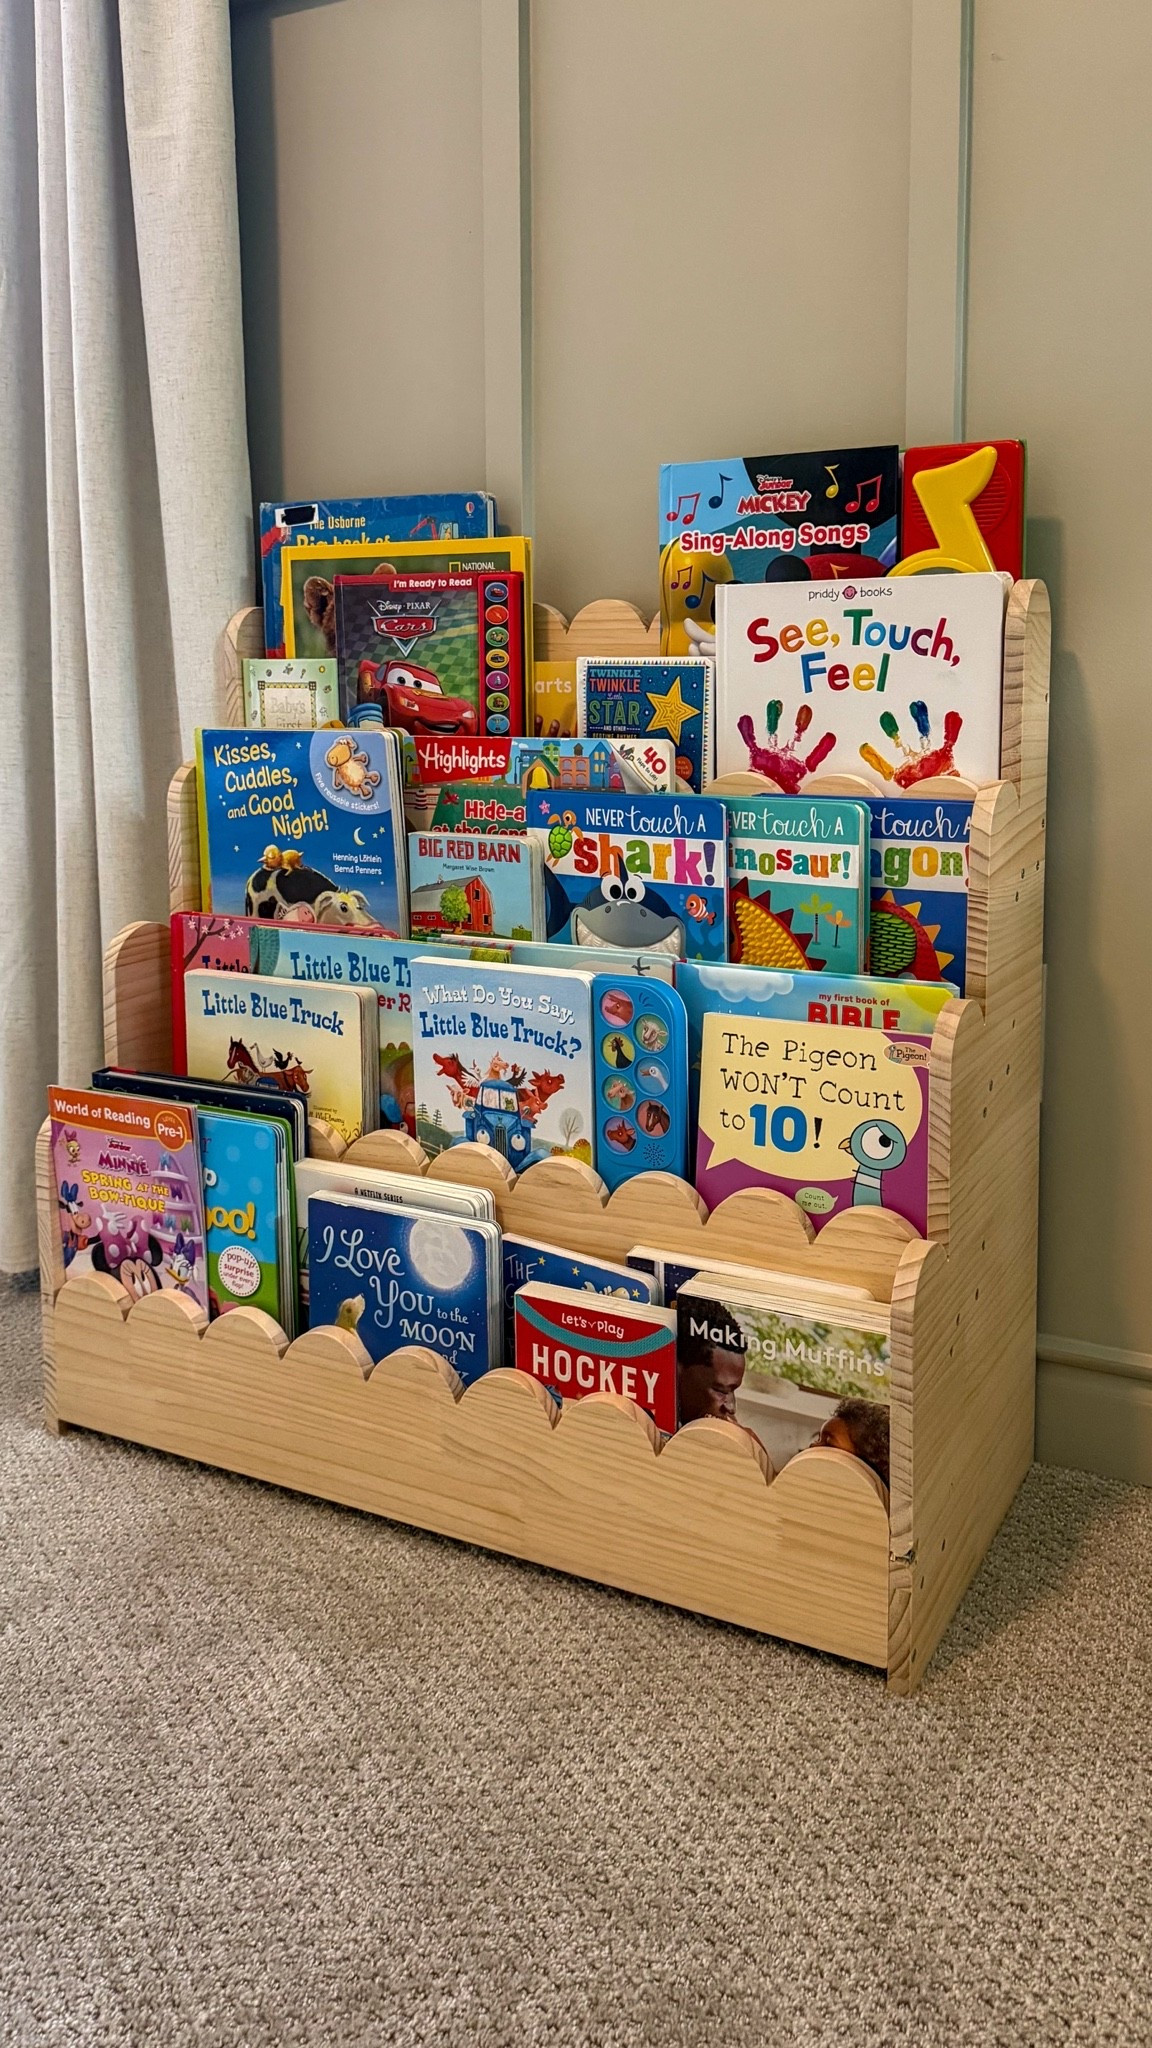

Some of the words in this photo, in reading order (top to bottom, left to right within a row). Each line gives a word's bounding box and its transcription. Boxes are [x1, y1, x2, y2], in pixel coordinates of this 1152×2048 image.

[737, 490, 812, 515] MICKEY
[328, 516, 366, 530] Usborne
[680, 526, 796, 555] Sing-Along
[798, 522, 871, 547] Songs
[462, 562, 496, 571] NATIONAL
[393, 580, 407, 588] I'm
[409, 579, 436, 588] Ready
[438, 579, 447, 587] to
[449, 578, 472, 587] Read
[808, 588, 840, 602] priddy
[860, 585, 893, 598] books
[376, 600, 402, 613] Disney
[406, 602, 432, 610] PIXAR
[380, 619, 428, 632] Cars
[746, 617, 840, 663] See,
[843, 608, 961, 667] Touch,
[589, 668, 641, 678] TWINKLE
[589, 678, 641, 692] TWINKLE
[800, 651, 891, 694] Feel
[589, 700, 640, 726] STAR
[213, 742, 276, 767] Kisses,
[418, 743, 506, 774] Highlights
[643, 746, 667, 775] 40
[225, 766, 299, 793] Cuddles,
[227, 804, 247, 819] and
[248, 789, 295, 816] Good
[323, 786, 350, 807] reusable
[350, 801, 380, 811] stickers!
[465, 799, 526, 822] Hide-a
[271, 808, 330, 840] Night!
[585, 808, 625, 827] NEVER
[625, 805, 695, 836] touch
[697, 813, 707, 832] A
[728, 811, 756, 830] VER
[757, 807, 832, 838] touch
[834, 816, 844, 836] A
[875, 806, 960, 838] touch
[332, 853, 358, 863] Henning
[418, 838, 443, 858] BIG
[447, 840, 474, 860] RED
[478, 842, 521, 863] BARN
[573, 833, 716, 887] shark!
[334, 864, 354, 873] Bernd
[355, 866, 383, 875] Penners
[442, 863, 464, 871] Margaret
[290, 951, 343, 980] Little
[348, 951, 391, 983] Blue
[422, 984, 468, 1005] What
[472, 984, 497, 1005] Do
[498, 987, 534, 1011] You
[537, 995, 576, 1025] Say,
[819, 994, 832, 1002] my
[834, 993, 853, 1003] first
[855, 995, 877, 1005] book
[202, 989, 247, 1016] Little
[250, 992, 288, 1020] Blue
[289, 997, 344, 1036] Truck
[807, 1001, 902, 1031] BIBLE
[419, 1011, 467, 1039] Little
[471, 1012, 509, 1040] Blue
[510, 1016, 582, 1060] Truck?
[722, 1032, 770, 1058] The
[782, 1039, 877, 1072] Pigeon
[896, 1050, 927, 1062] Pigeon!
[720, 1068, 807, 1098] WON'T
[819, 1080, 906, 1111] Count
[54, 1099, 89, 1116] World
[91, 1107, 102, 1118] of
[104, 1107, 151, 1128] Reading
[720, 1108, 746, 1131] to
[158, 1123, 183, 1139] Pre-1
[98, 1151, 151, 1176] MINNIE
[81, 1169, 132, 1192] SPRING
[136, 1183, 149, 1192] AT
[151, 1184, 169, 1196] THE
[360, 1188, 382, 1199] NETFLIX
[383, 1192, 403, 1203] SERIES
[88, 1187, 166, 1212] BOW-TIQUE
[804, 1192, 825, 1201] Count
[316, 1225, 335, 1263] I
[223, 1261, 255, 1278] surprise
[226, 1252, 256, 1269] pop-up
[504, 1253, 538, 1282] THE
[437, 1307, 448, 1319] to
[450, 1307, 469, 1324] the
[561, 1313, 587, 1328] Let's
[597, 1320, 625, 1339] Play
[399, 1318, 476, 1353] MOON
[689, 1316, 777, 1361] Making
[785, 1338, 885, 1377] Muffins
[532, 1343, 660, 1404] HOCKEY
